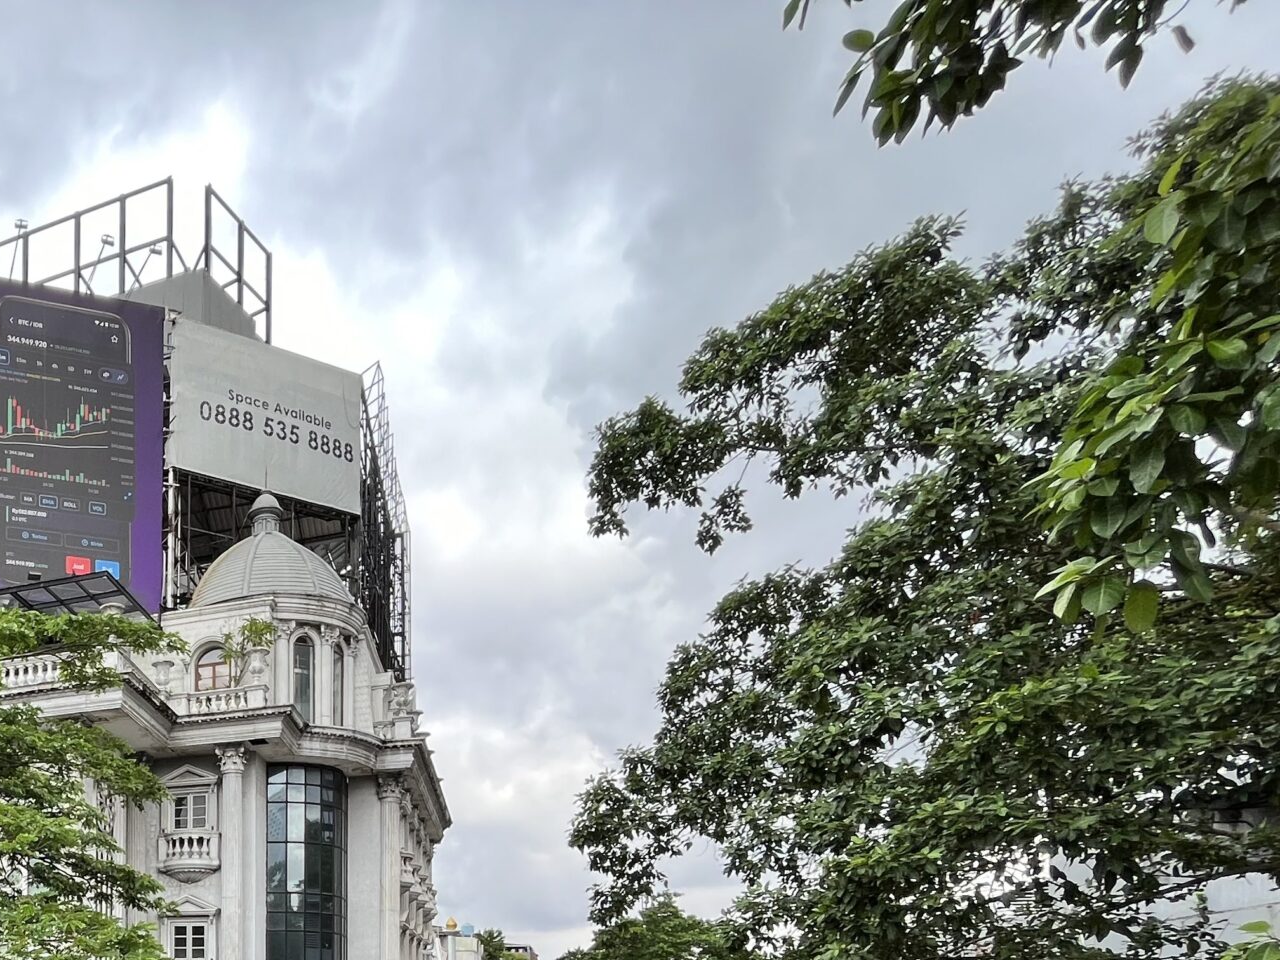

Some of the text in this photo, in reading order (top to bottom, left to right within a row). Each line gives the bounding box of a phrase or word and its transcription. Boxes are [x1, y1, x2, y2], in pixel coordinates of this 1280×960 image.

[7, 334, 47, 349] 344.949.920
[228, 389, 332, 430] Space Available
[200, 400, 354, 463] 0888 535 8888
